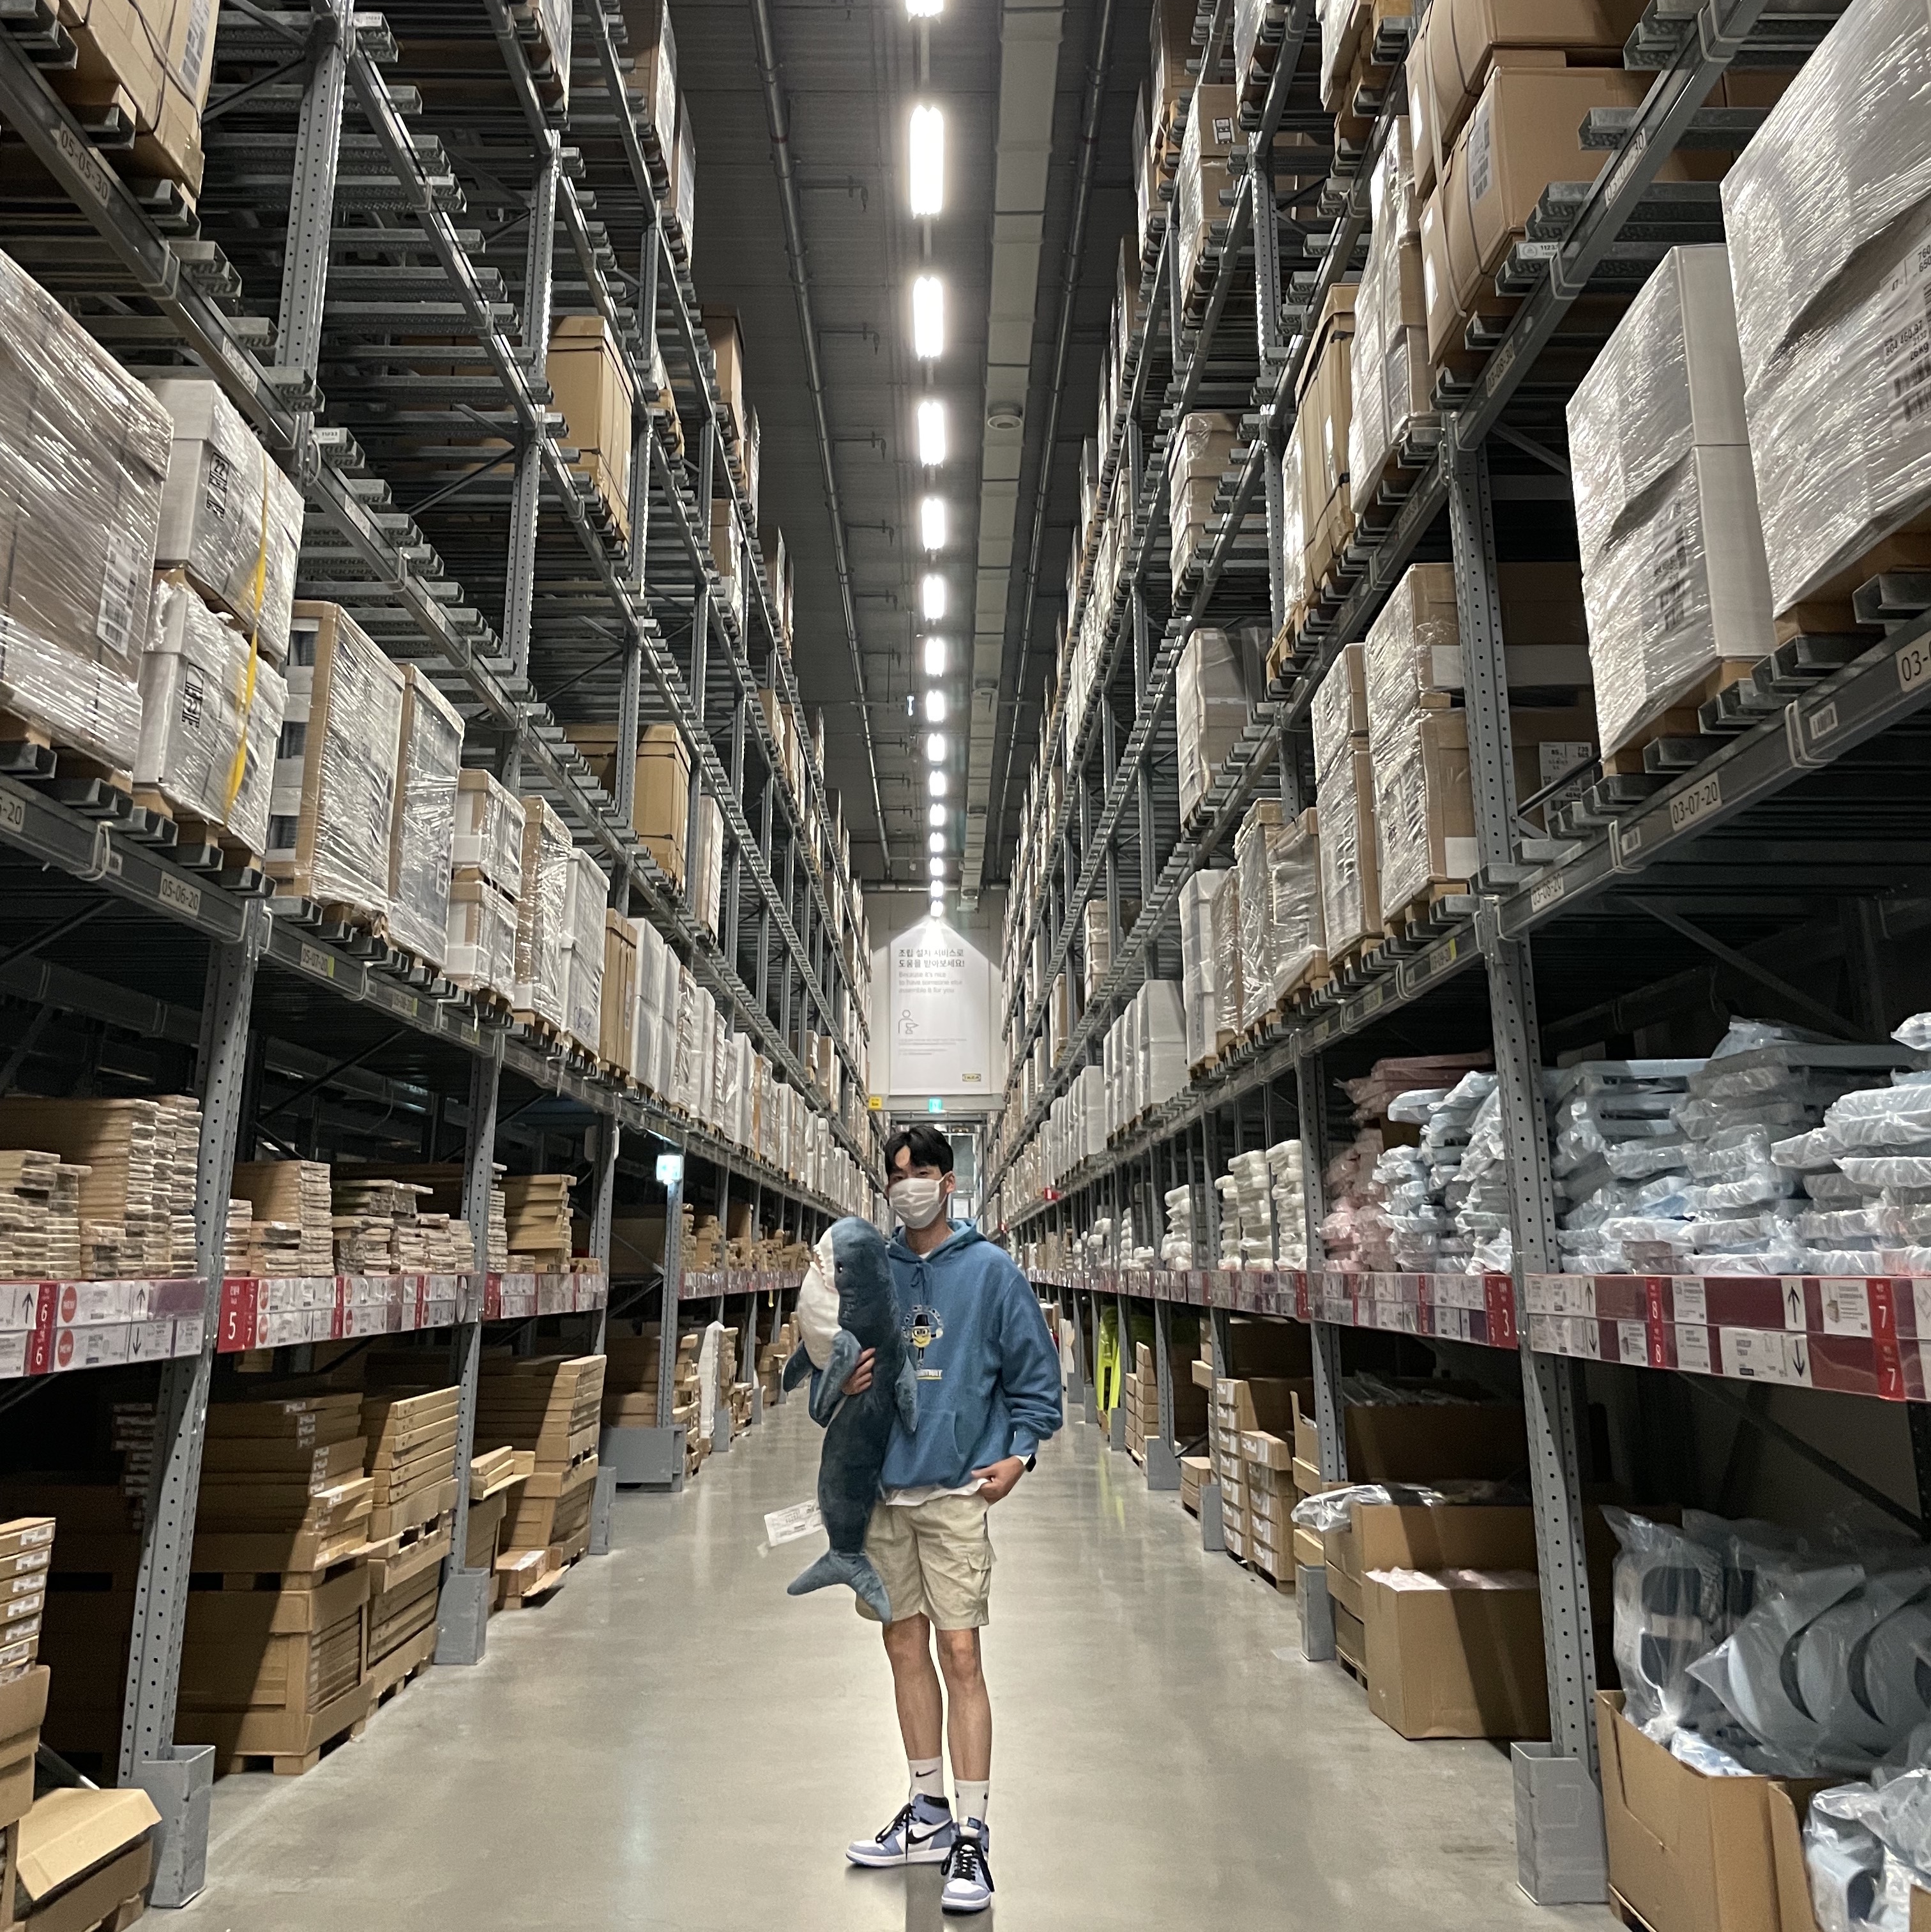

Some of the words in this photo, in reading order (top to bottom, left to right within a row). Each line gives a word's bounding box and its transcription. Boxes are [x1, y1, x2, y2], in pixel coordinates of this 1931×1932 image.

[61, 130, 108, 199] 05-05-30
[1918, 245, 1931, 262] 760
[1902, 641, 1931, 681] 03-
[1673, 782, 1718, 824] 03-07-20
[162, 879, 199, 909] 05-06-20
[898, 948, 912, 957] 조립
[916, 948, 930, 957] 설치
[934, 948, 964, 957] 서비스로
[898, 959, 920, 968] 도움을
[41, 1304, 49, 1322] 6
[1651, 1300, 1658, 1319] 8
[1878, 1305, 1886, 1328] 7
[228, 1311, 237, 1340] 5
[1502, 1309, 1510, 1337] 3
[36, 1346, 43, 1366] 6
[1655, 1344, 1662, 1363] 8
[1887, 1368, 1895, 1390] 7
